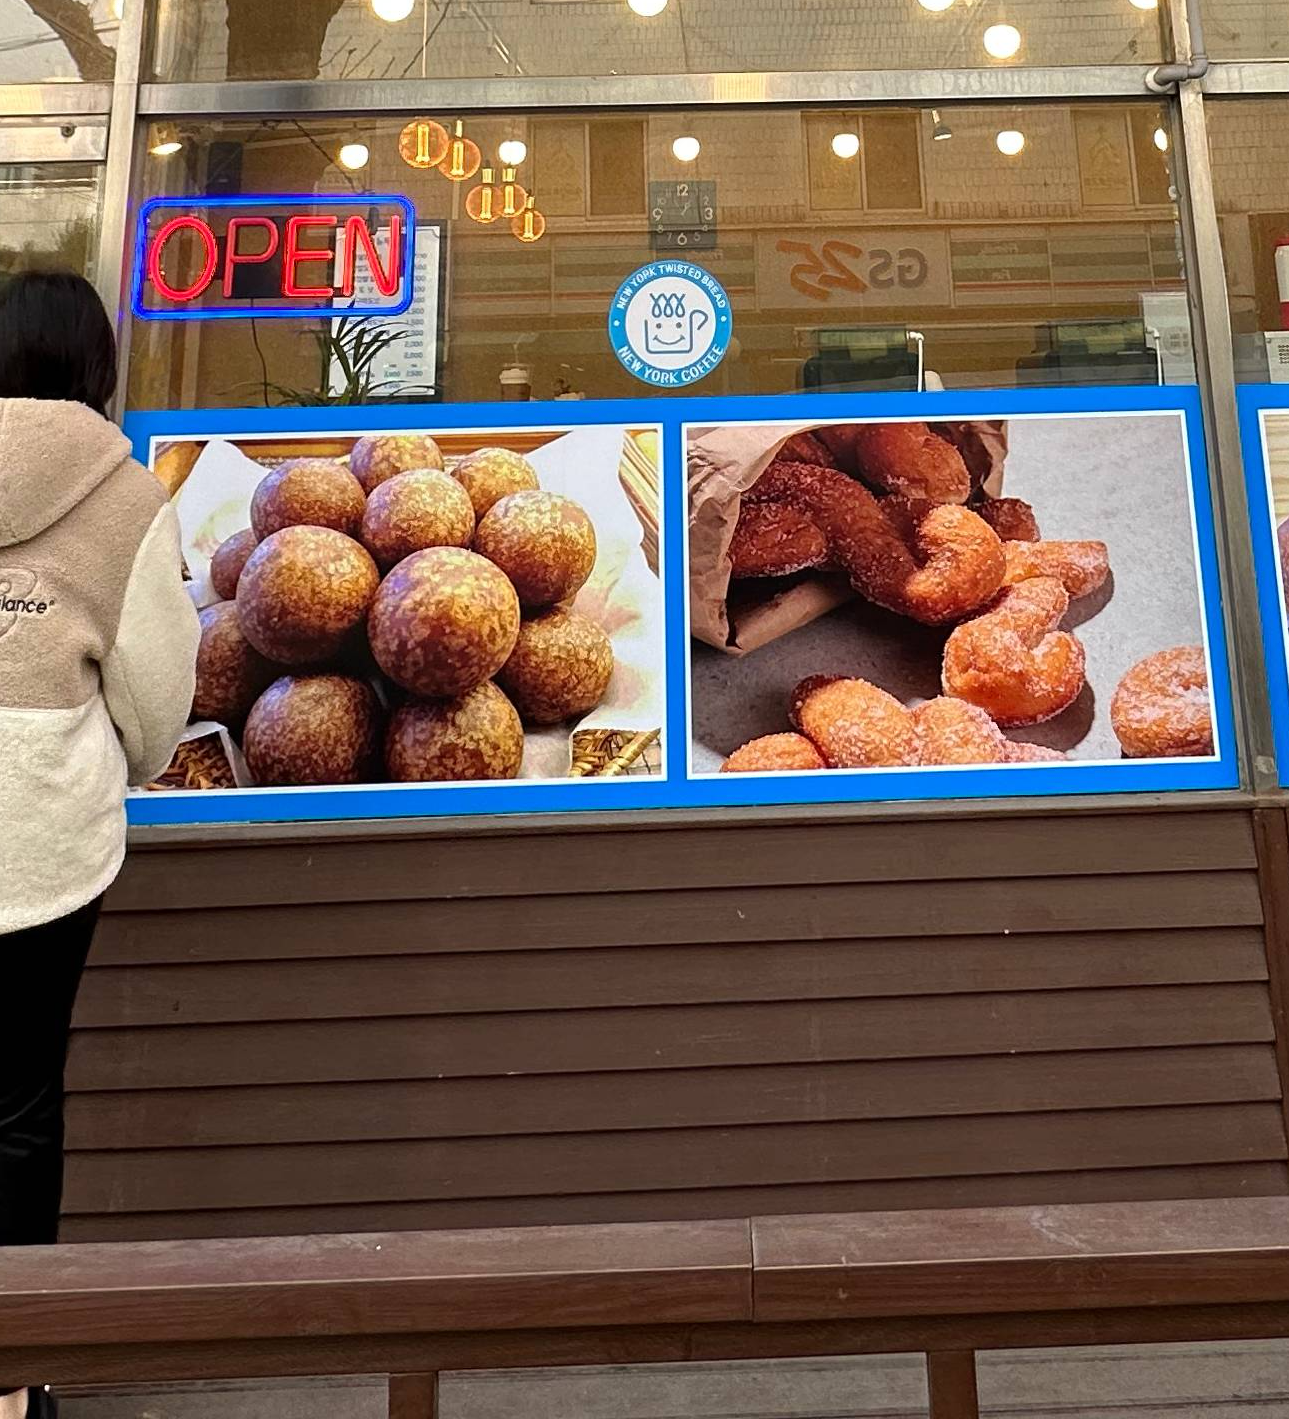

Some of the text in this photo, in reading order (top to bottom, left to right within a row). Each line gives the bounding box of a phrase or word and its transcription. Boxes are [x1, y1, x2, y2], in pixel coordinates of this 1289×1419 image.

[677, 184, 688, 196] 12
[704, 207, 713, 220] 3
[677, 232, 687, 245] 6
[148, 214, 402, 303] OPEN
[616, 263, 727, 311] NEW YORK TWISTED BREAD
[617, 345, 725, 384] NEW YORK COFFEE
